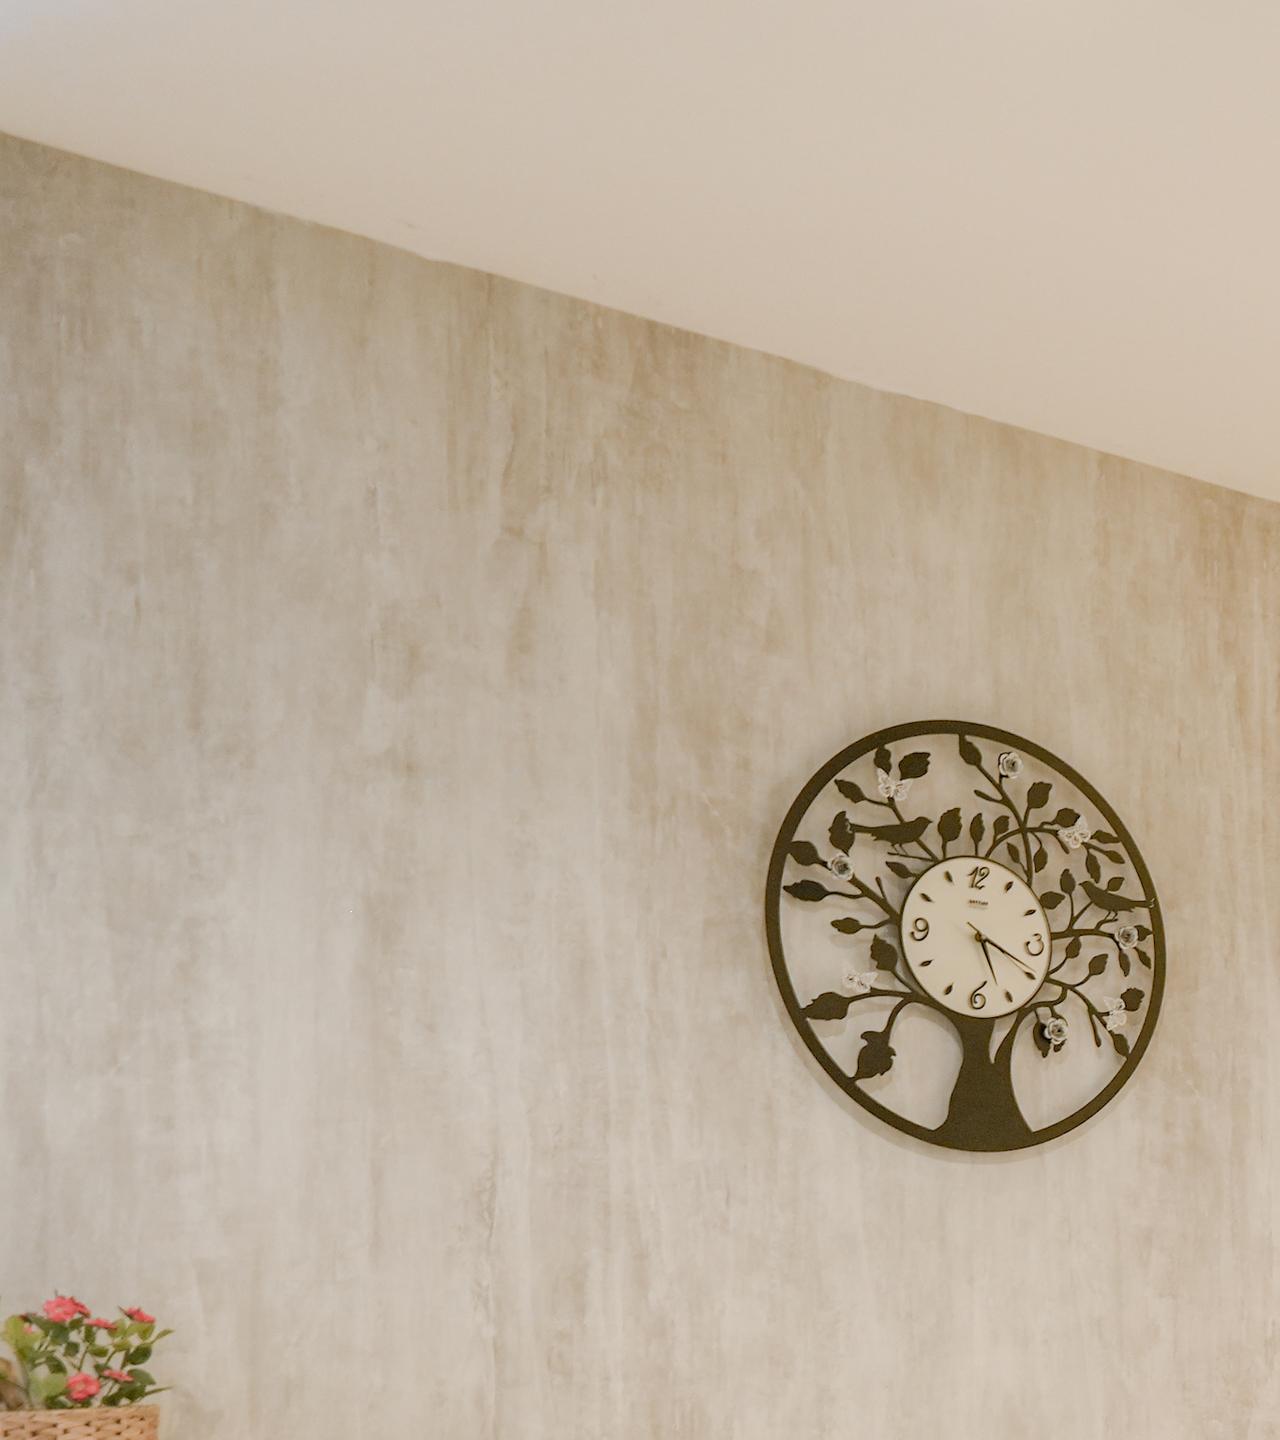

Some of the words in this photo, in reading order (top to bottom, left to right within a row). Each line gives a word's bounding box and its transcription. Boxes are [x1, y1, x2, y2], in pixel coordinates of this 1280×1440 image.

[967, 866, 990, 890] 12
[910, 917, 930, 942] 9
[1025, 933, 1045, 957] 3
[970, 980, 988, 1010] 6
